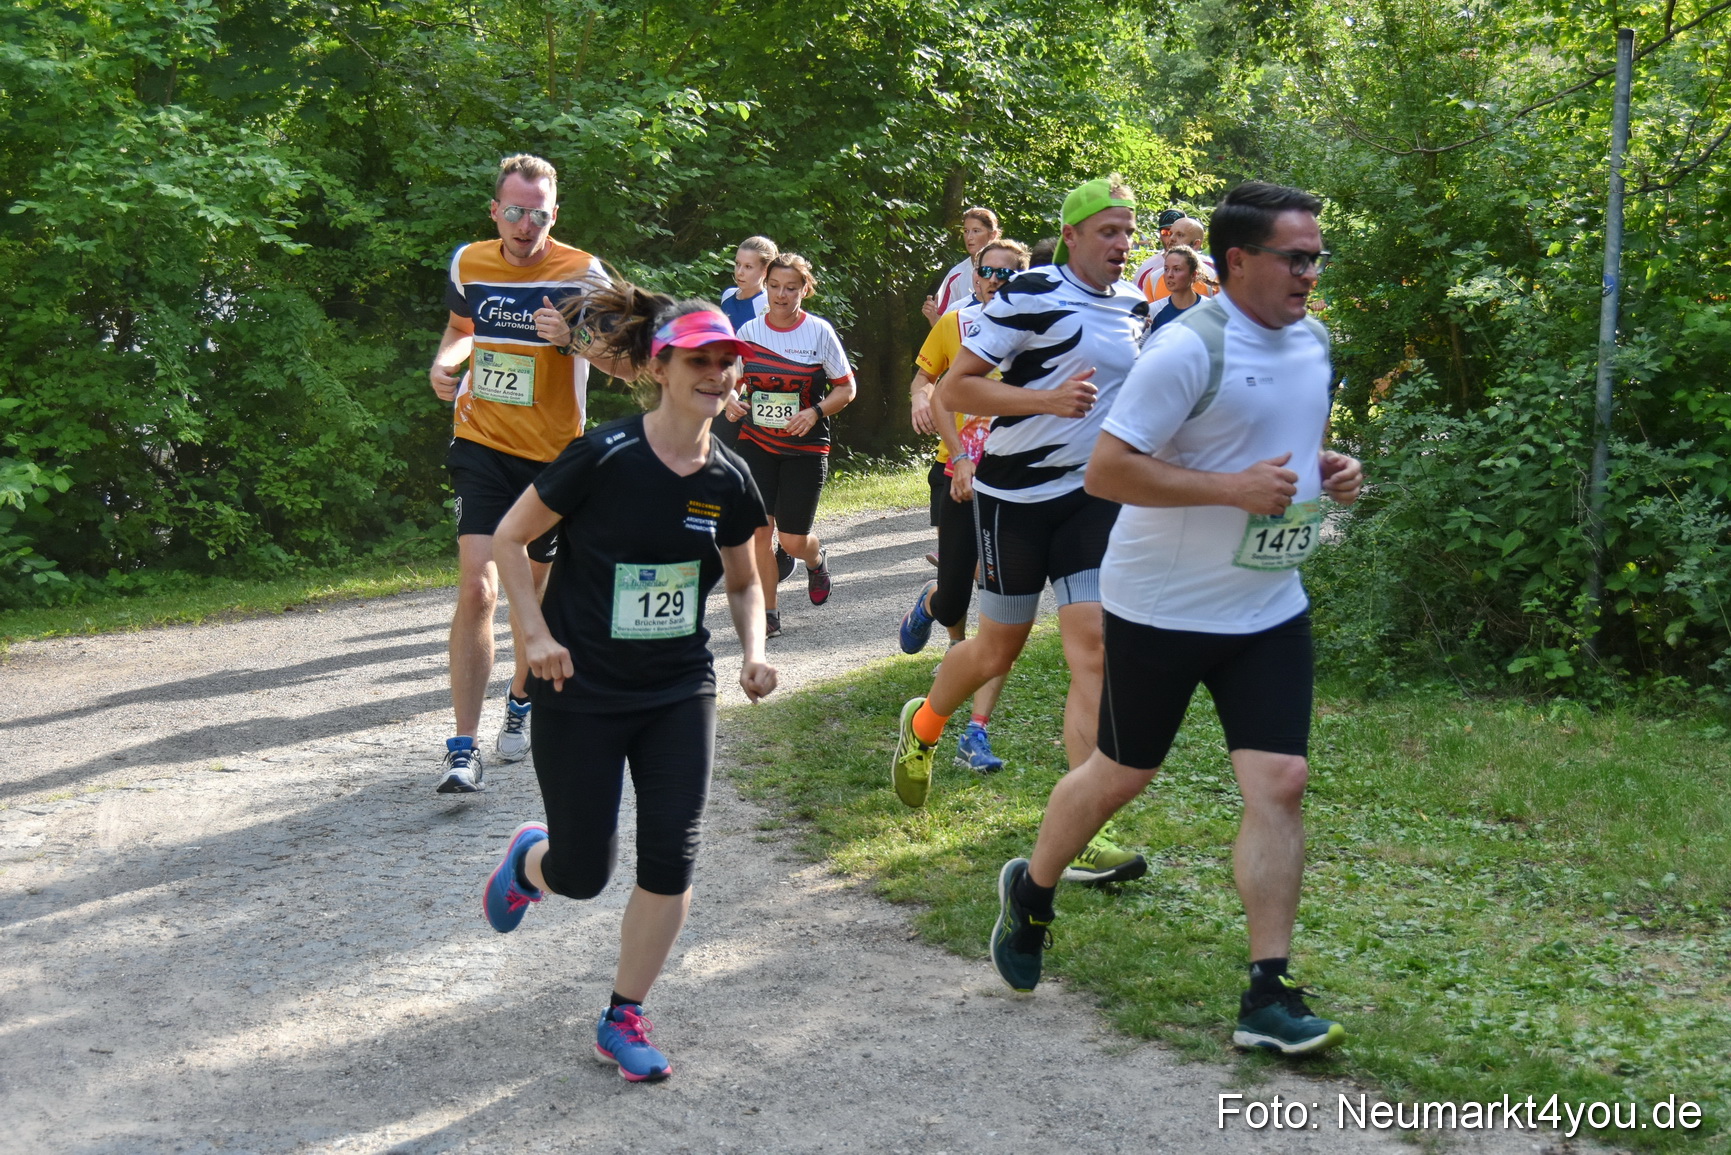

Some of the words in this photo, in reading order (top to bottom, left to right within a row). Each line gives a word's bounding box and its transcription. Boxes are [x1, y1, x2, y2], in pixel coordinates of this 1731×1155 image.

[488, 307, 532, 322] Fisch
[495, 321, 536, 331] AUTOMOB
[482, 368, 518, 390] 772
[756, 404, 792, 418] 2238
[1256, 526, 1312, 552] 1473
[638, 590, 684, 618] 129
[634, 618, 668, 626] Brückner
